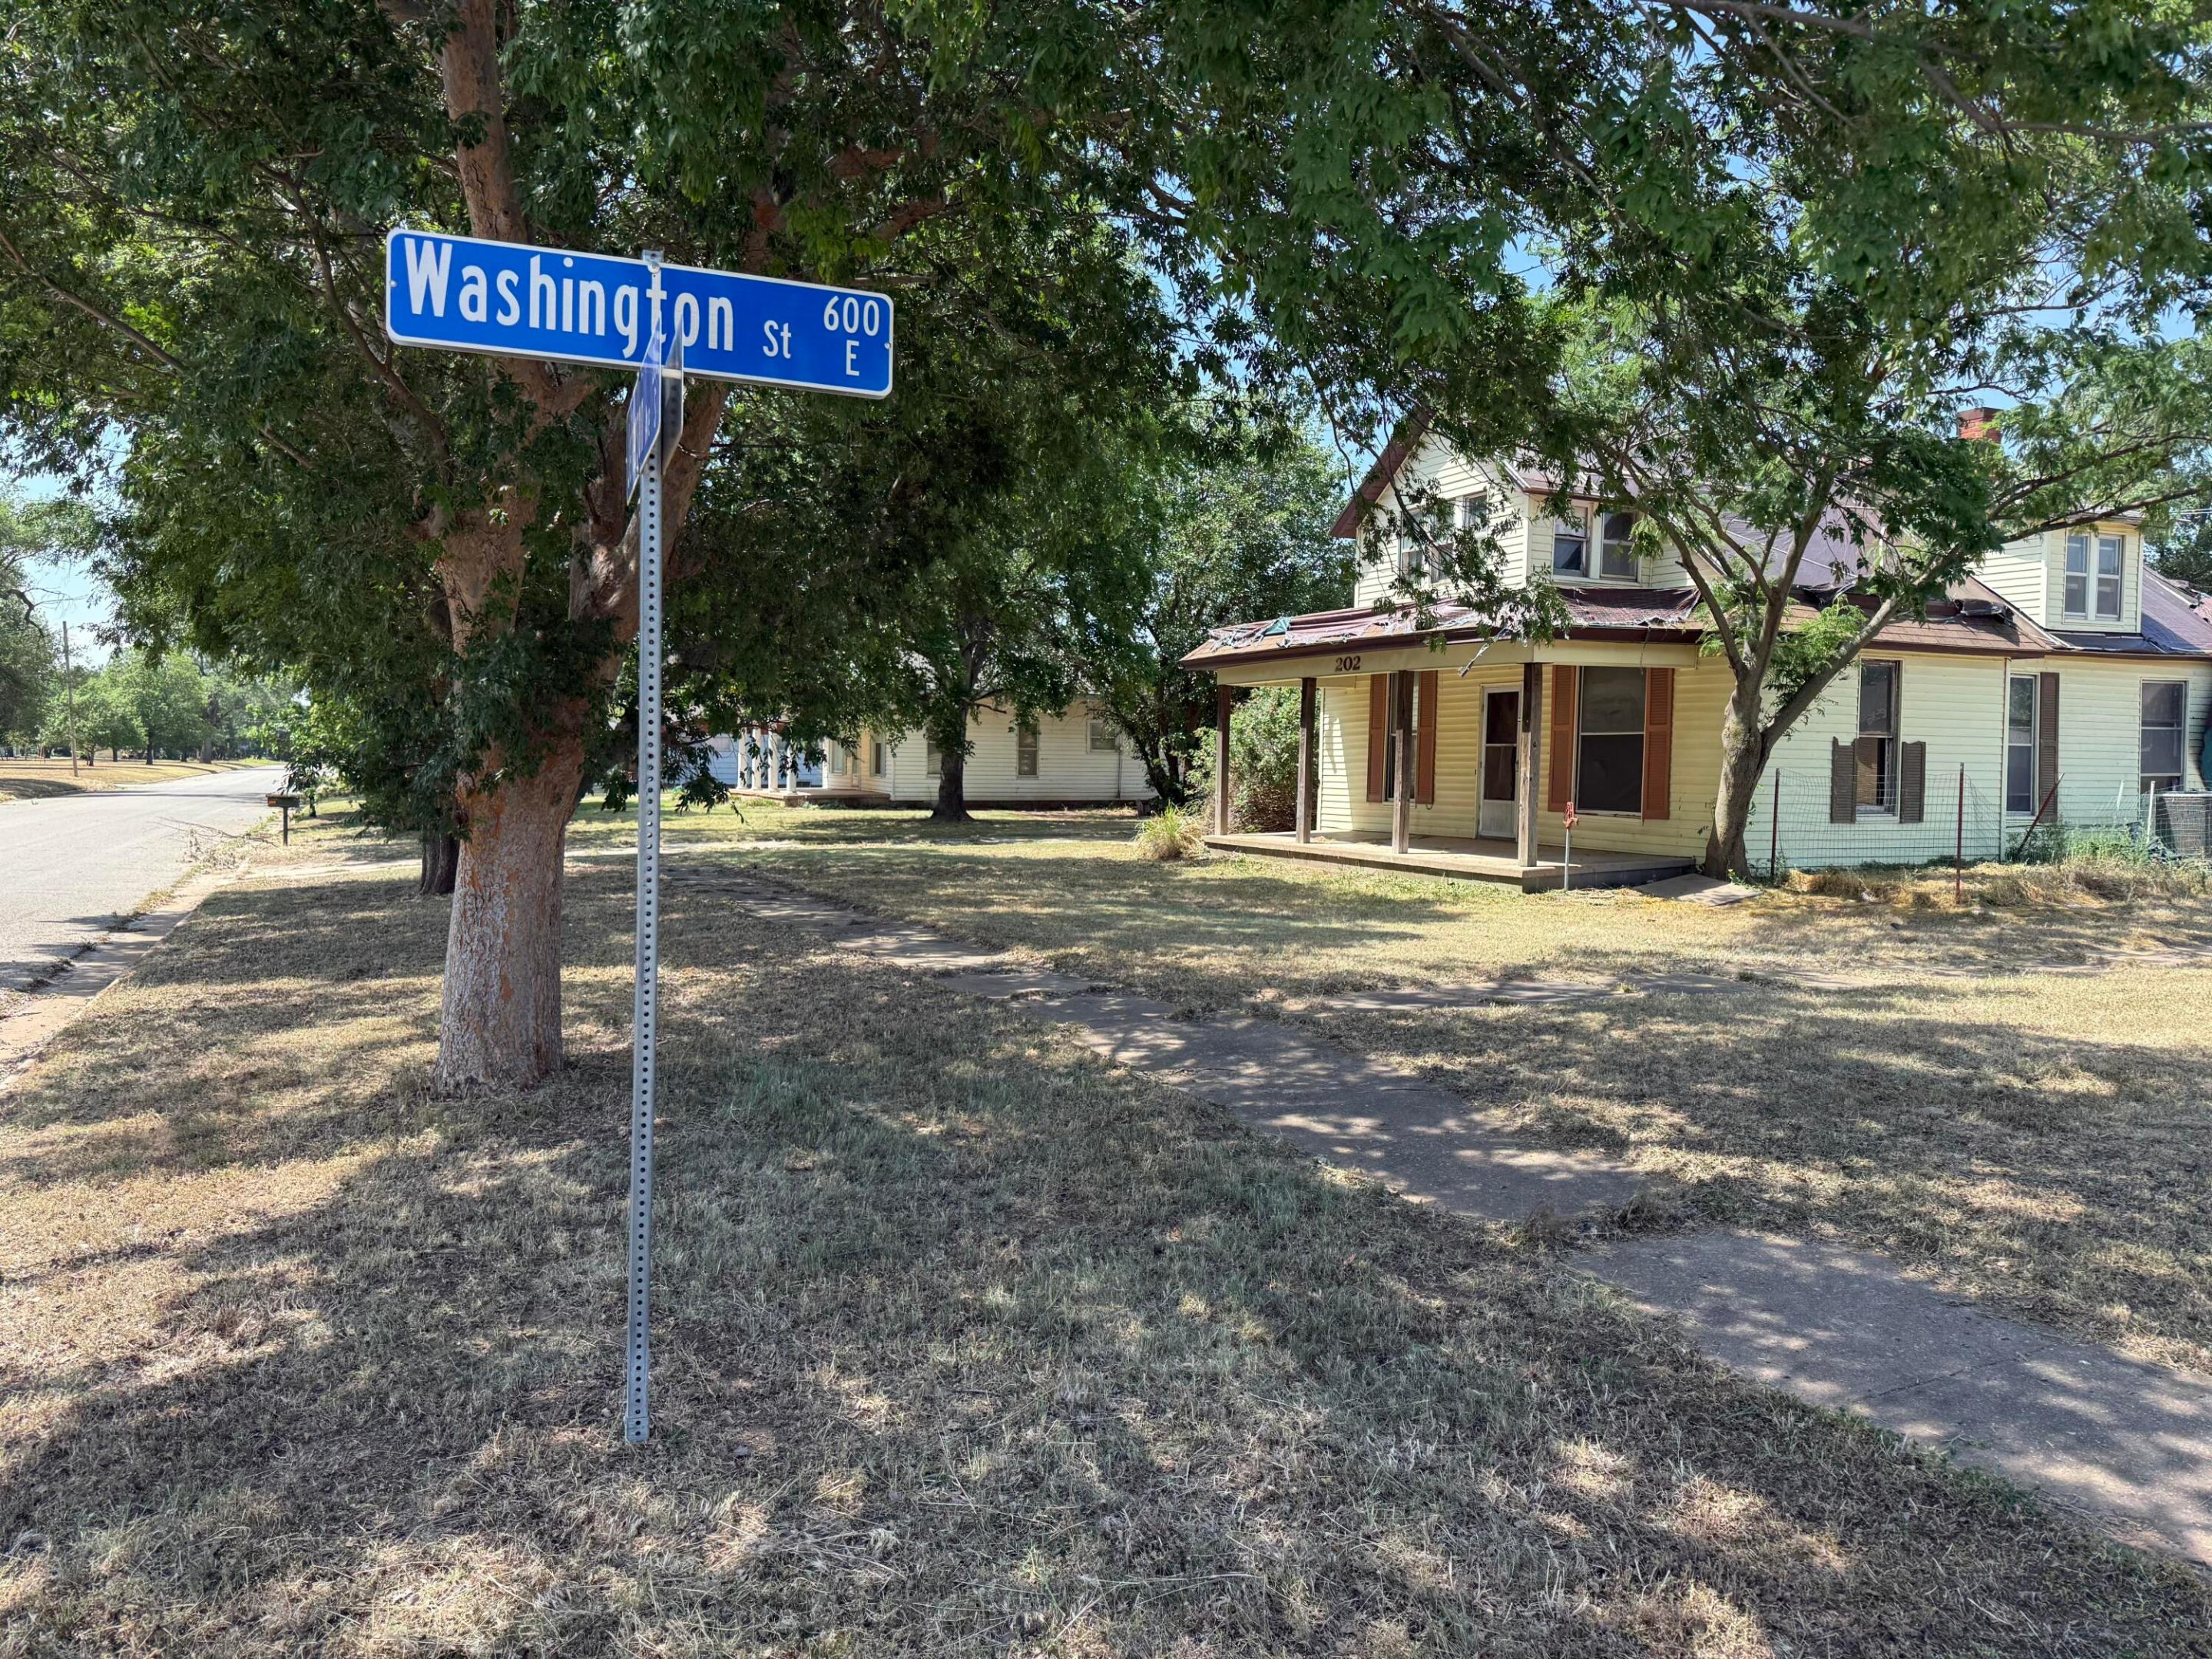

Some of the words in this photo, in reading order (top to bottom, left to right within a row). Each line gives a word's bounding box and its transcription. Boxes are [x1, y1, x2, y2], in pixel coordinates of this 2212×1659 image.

[404, 237, 734, 359] Washington
[763, 320, 792, 359] St
[823, 295, 880, 336] 600
[845, 339, 860, 376] E
[1335, 655, 1361, 672] 202
